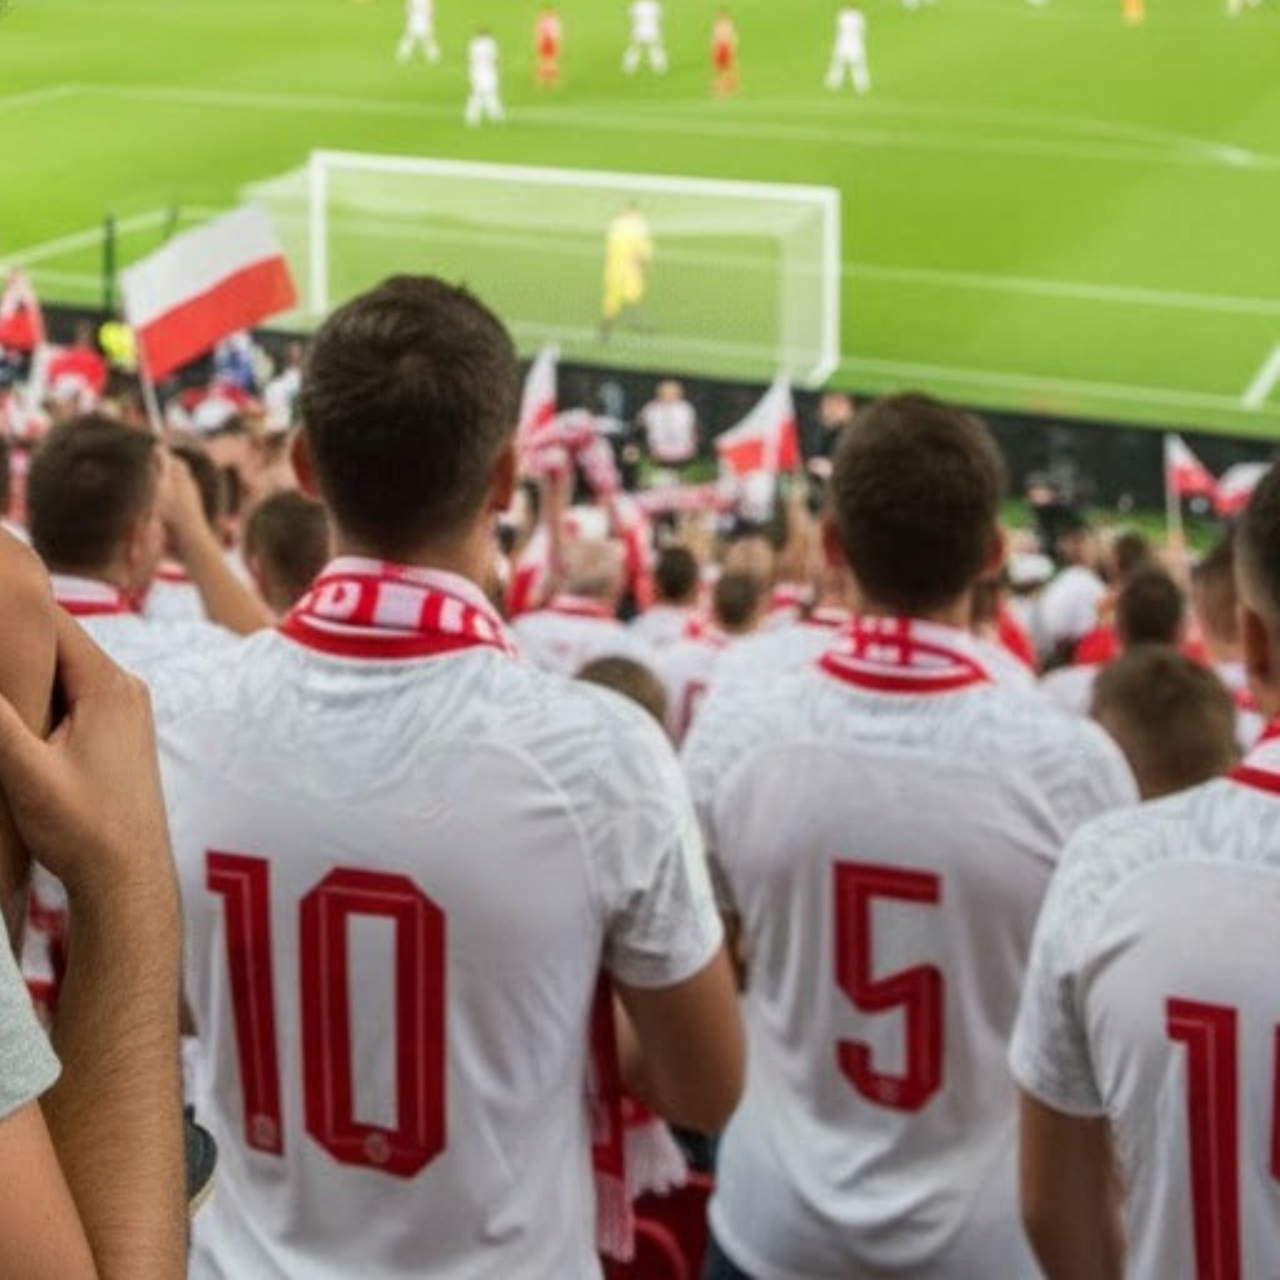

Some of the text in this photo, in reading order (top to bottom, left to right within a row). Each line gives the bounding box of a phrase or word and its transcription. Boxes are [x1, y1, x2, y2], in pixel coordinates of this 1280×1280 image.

[205, 849, 447, 1179] 10
[833, 858, 943, 1113] 5
[1165, 995, 1280, 1280] 1
